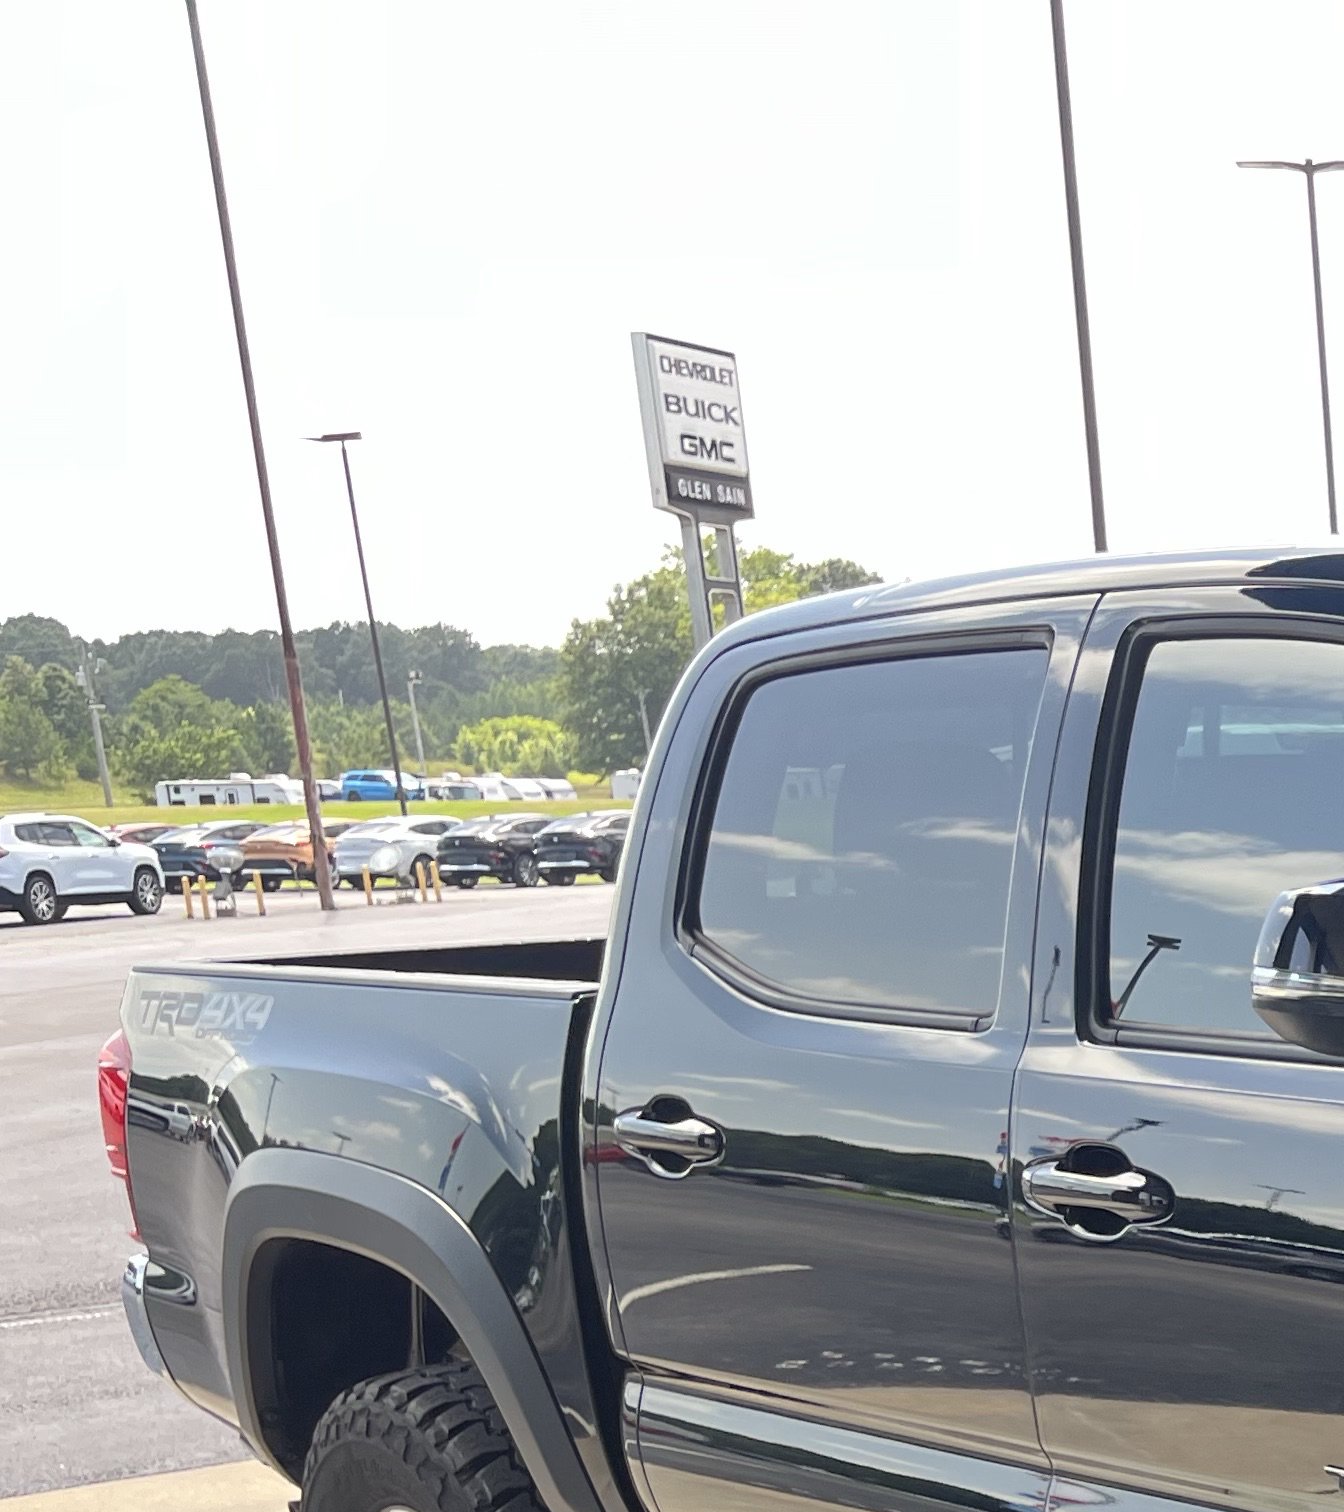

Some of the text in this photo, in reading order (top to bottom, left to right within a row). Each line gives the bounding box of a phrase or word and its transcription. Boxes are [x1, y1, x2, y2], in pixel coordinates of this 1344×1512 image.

[659, 354, 735, 388] CHEVROLET
[663, 392, 740, 427] BUICK
[680, 433, 736, 464] GMC
[677, 478, 747, 506] GLEN SAIN
[139, 990, 204, 1037] TRD
